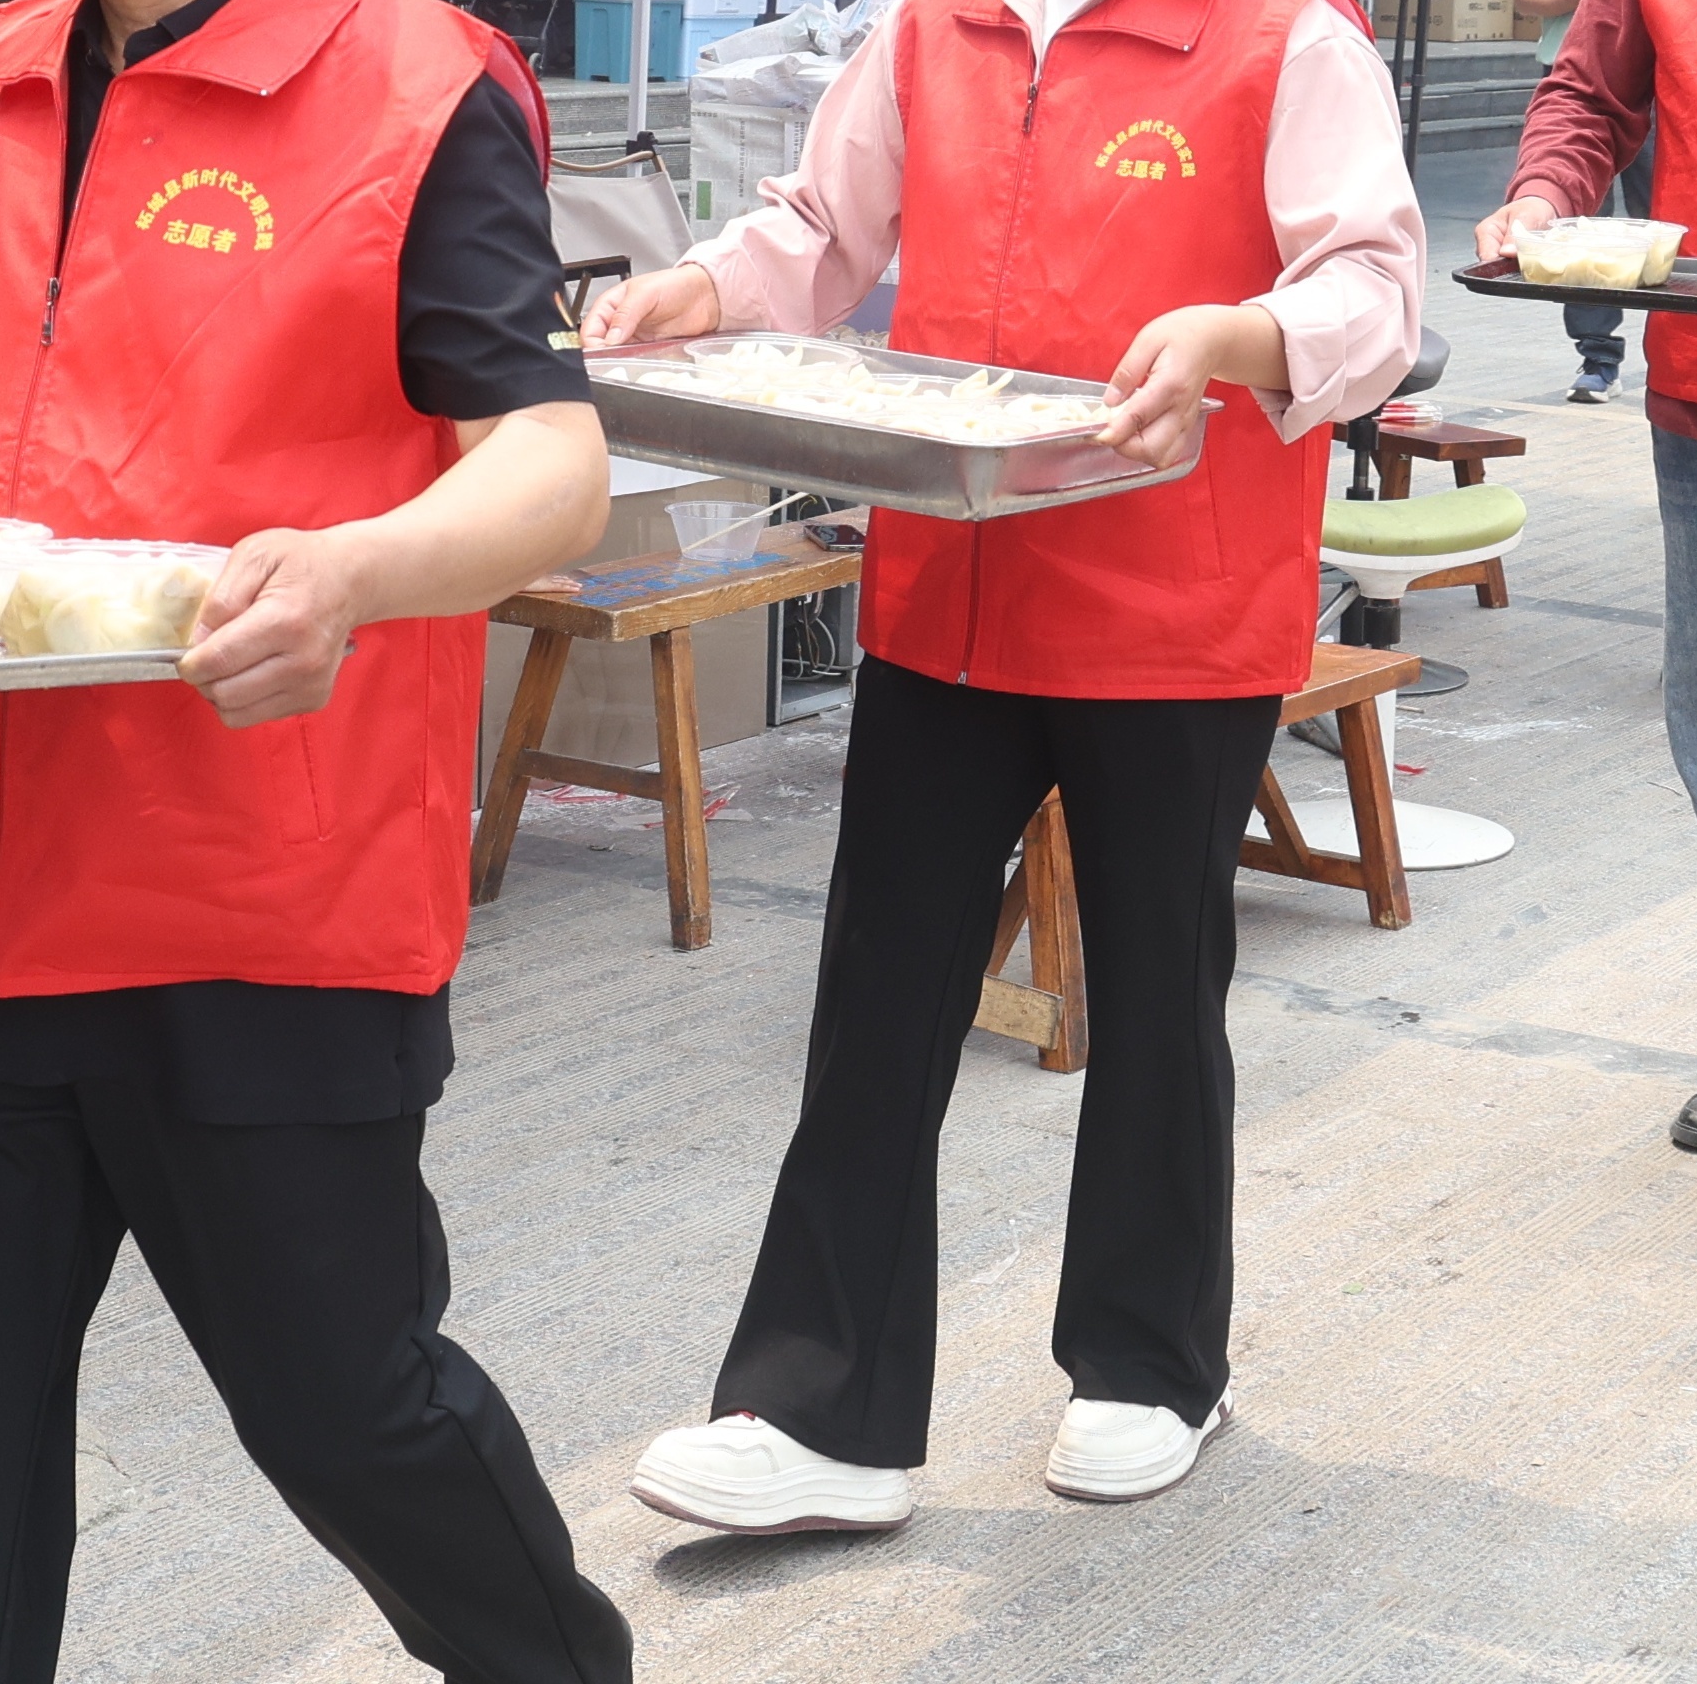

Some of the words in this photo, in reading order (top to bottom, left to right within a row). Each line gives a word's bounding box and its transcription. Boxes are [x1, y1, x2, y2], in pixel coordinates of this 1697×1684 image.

[1115, 158, 1167, 181] 志愿者
[163, 219, 237, 254] 志愿者
